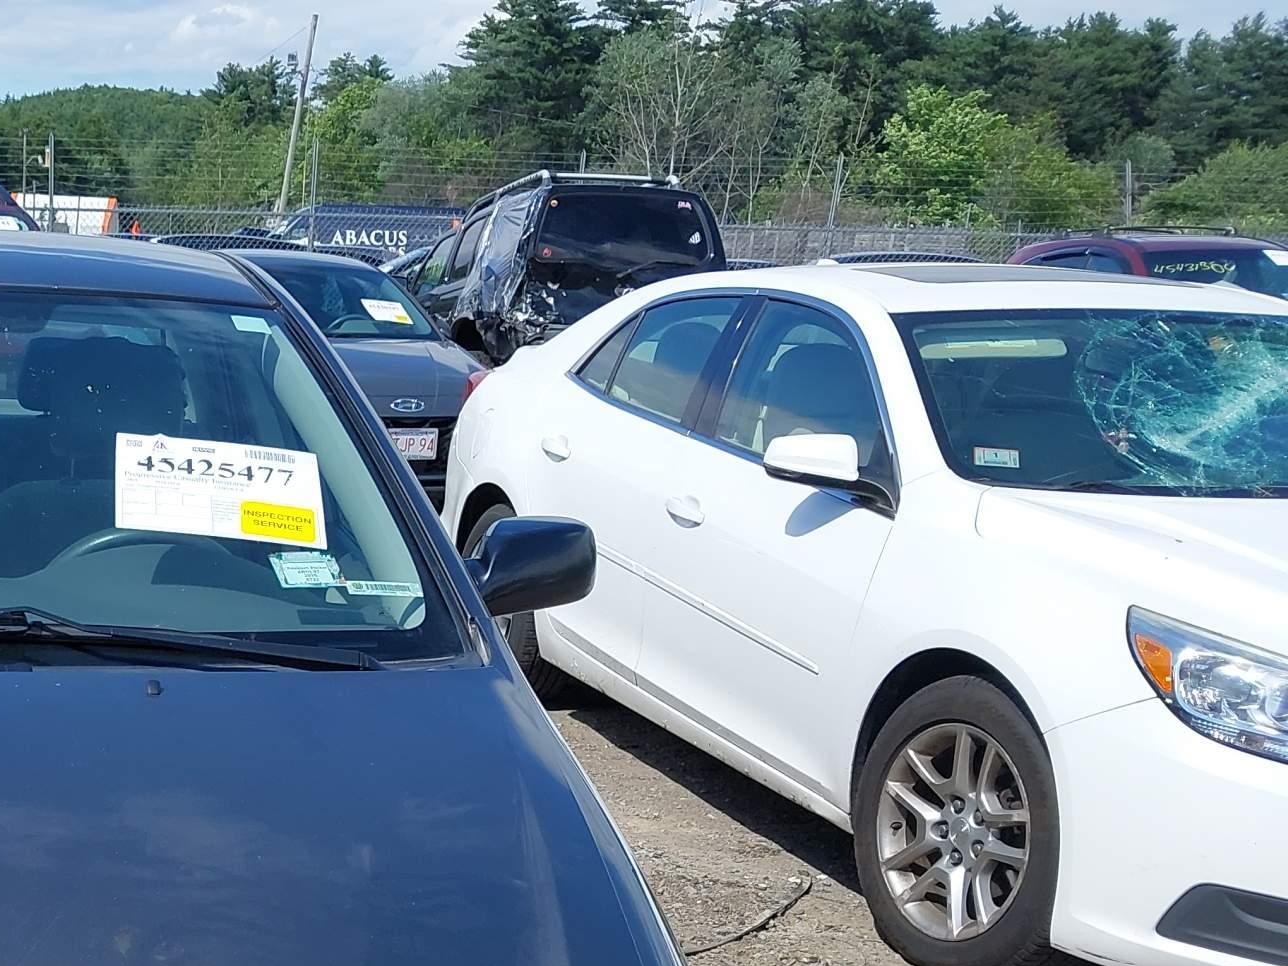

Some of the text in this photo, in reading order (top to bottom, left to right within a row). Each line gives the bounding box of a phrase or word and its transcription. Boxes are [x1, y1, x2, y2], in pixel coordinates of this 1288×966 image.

[331, 229, 408, 246] ABACUS
[419, 437, 434, 453] 94
[137, 455, 295, 487] 45425477
[243, 509, 312, 524] INSPECTION
[253, 519, 304, 532] SERVICE
